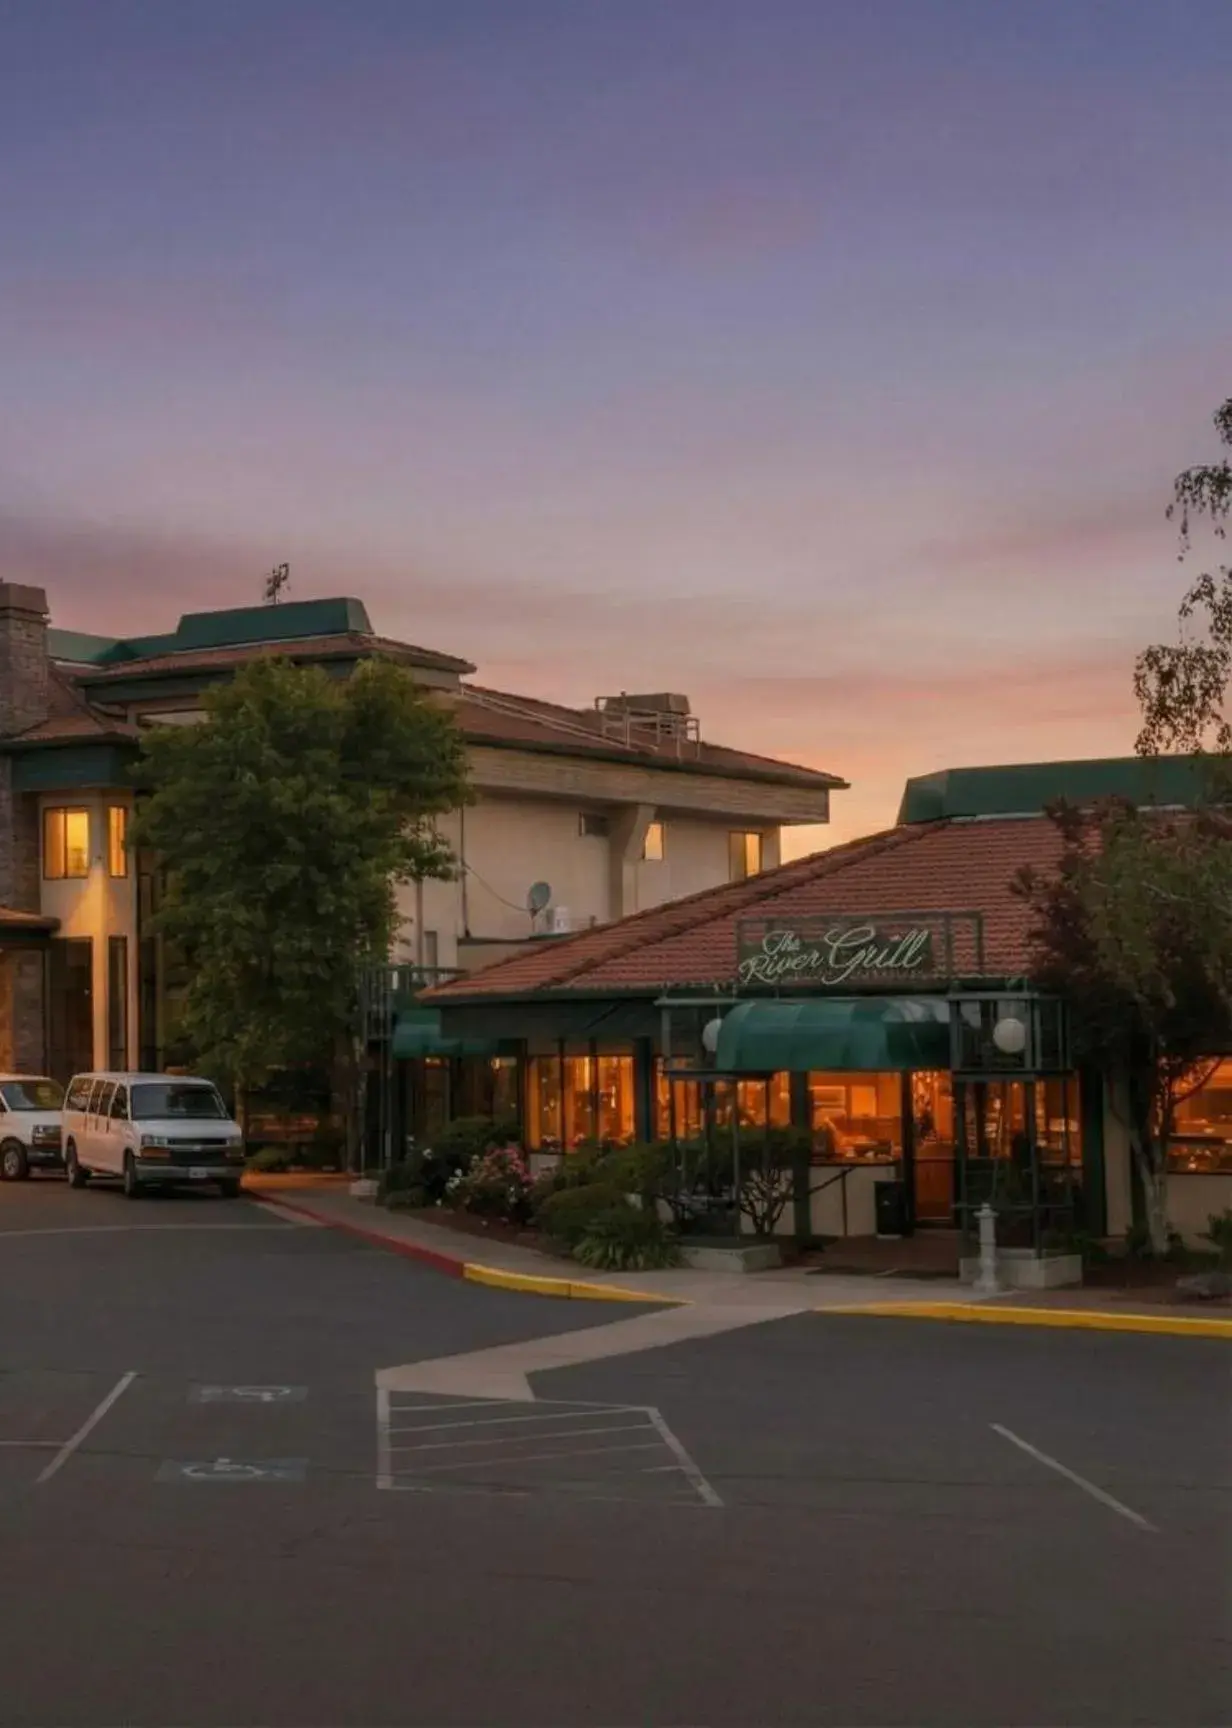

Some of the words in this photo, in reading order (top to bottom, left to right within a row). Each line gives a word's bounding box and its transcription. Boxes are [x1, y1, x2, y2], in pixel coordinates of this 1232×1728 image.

[738, 950, 822, 984] River
[821, 926, 929, 985] Grill
[763, 930, 801, 955] The
